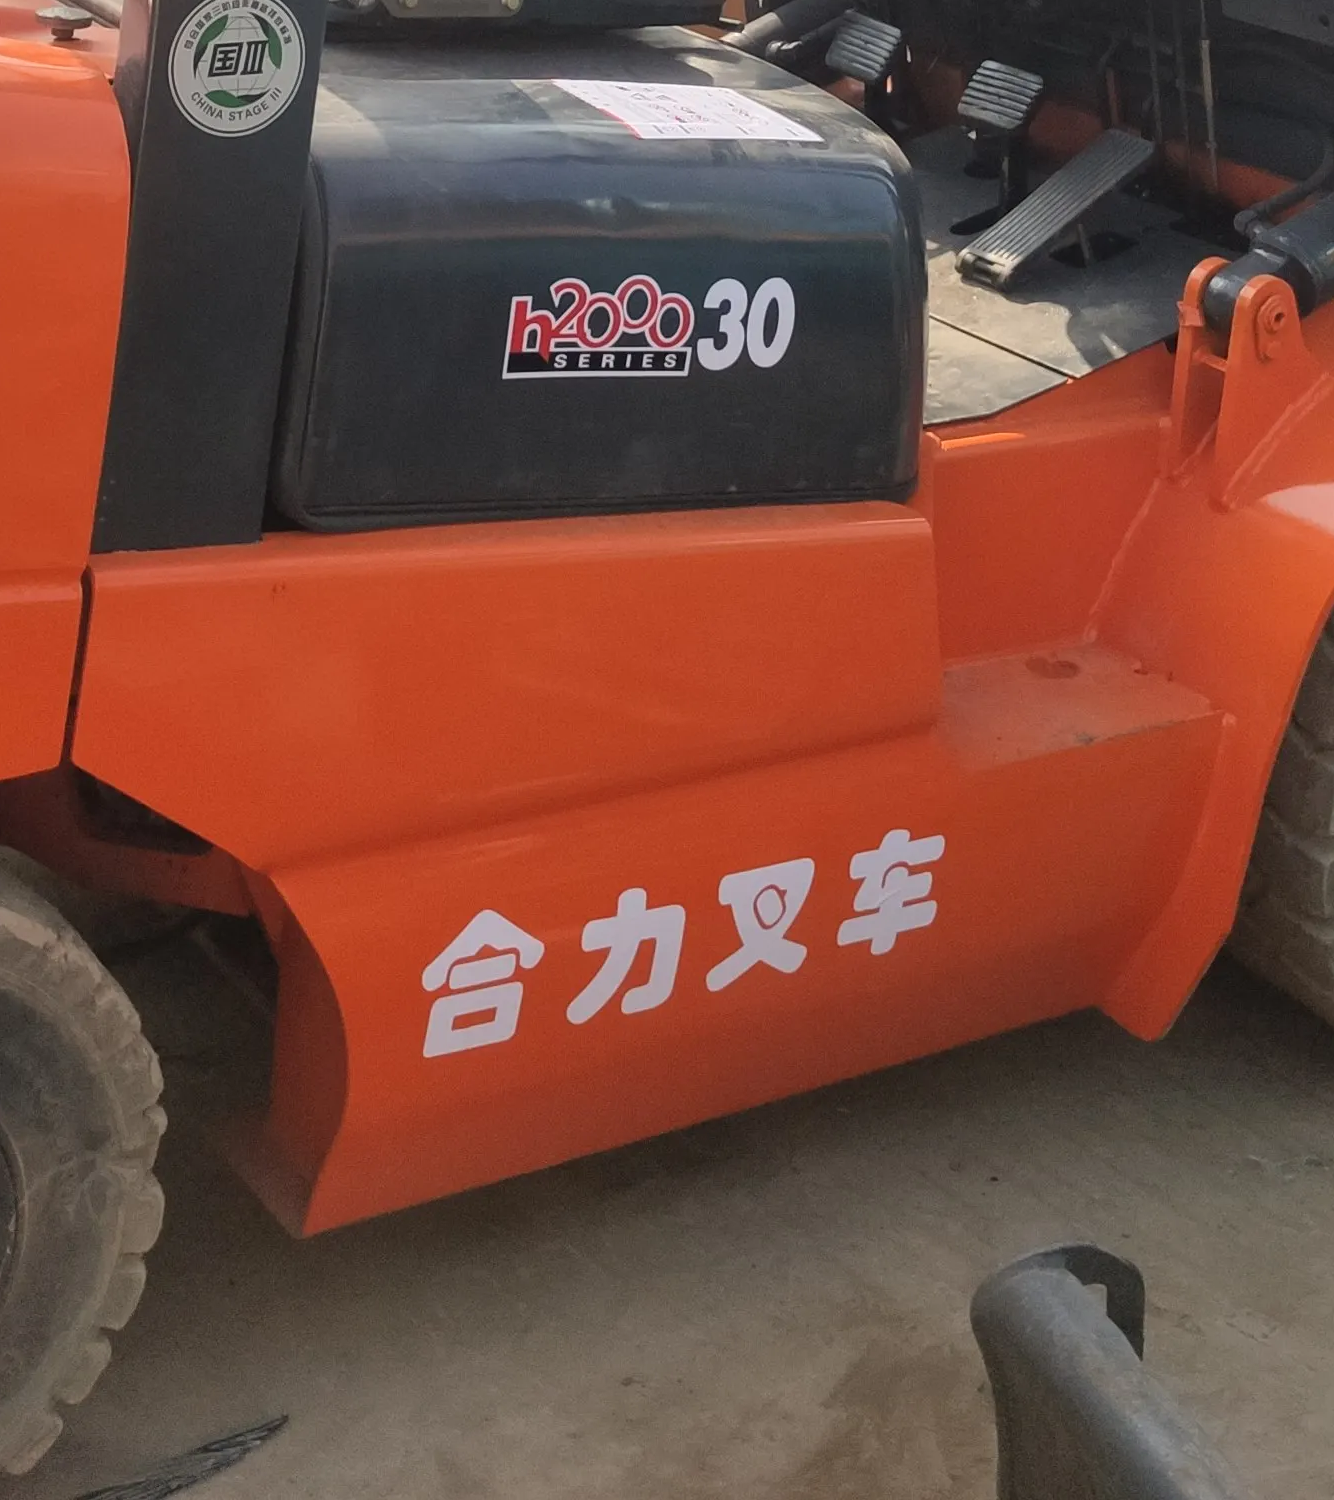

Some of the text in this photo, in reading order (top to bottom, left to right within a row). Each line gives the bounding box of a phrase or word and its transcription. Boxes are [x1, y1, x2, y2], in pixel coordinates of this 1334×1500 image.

[191, 91, 223, 120] CHINA
[228, 102, 269, 121] STAGE
[508, 276, 795, 370] h2000 30
[554, 353, 678, 369] SERIES
[421, 829, 945, 1058] 合力叉车
